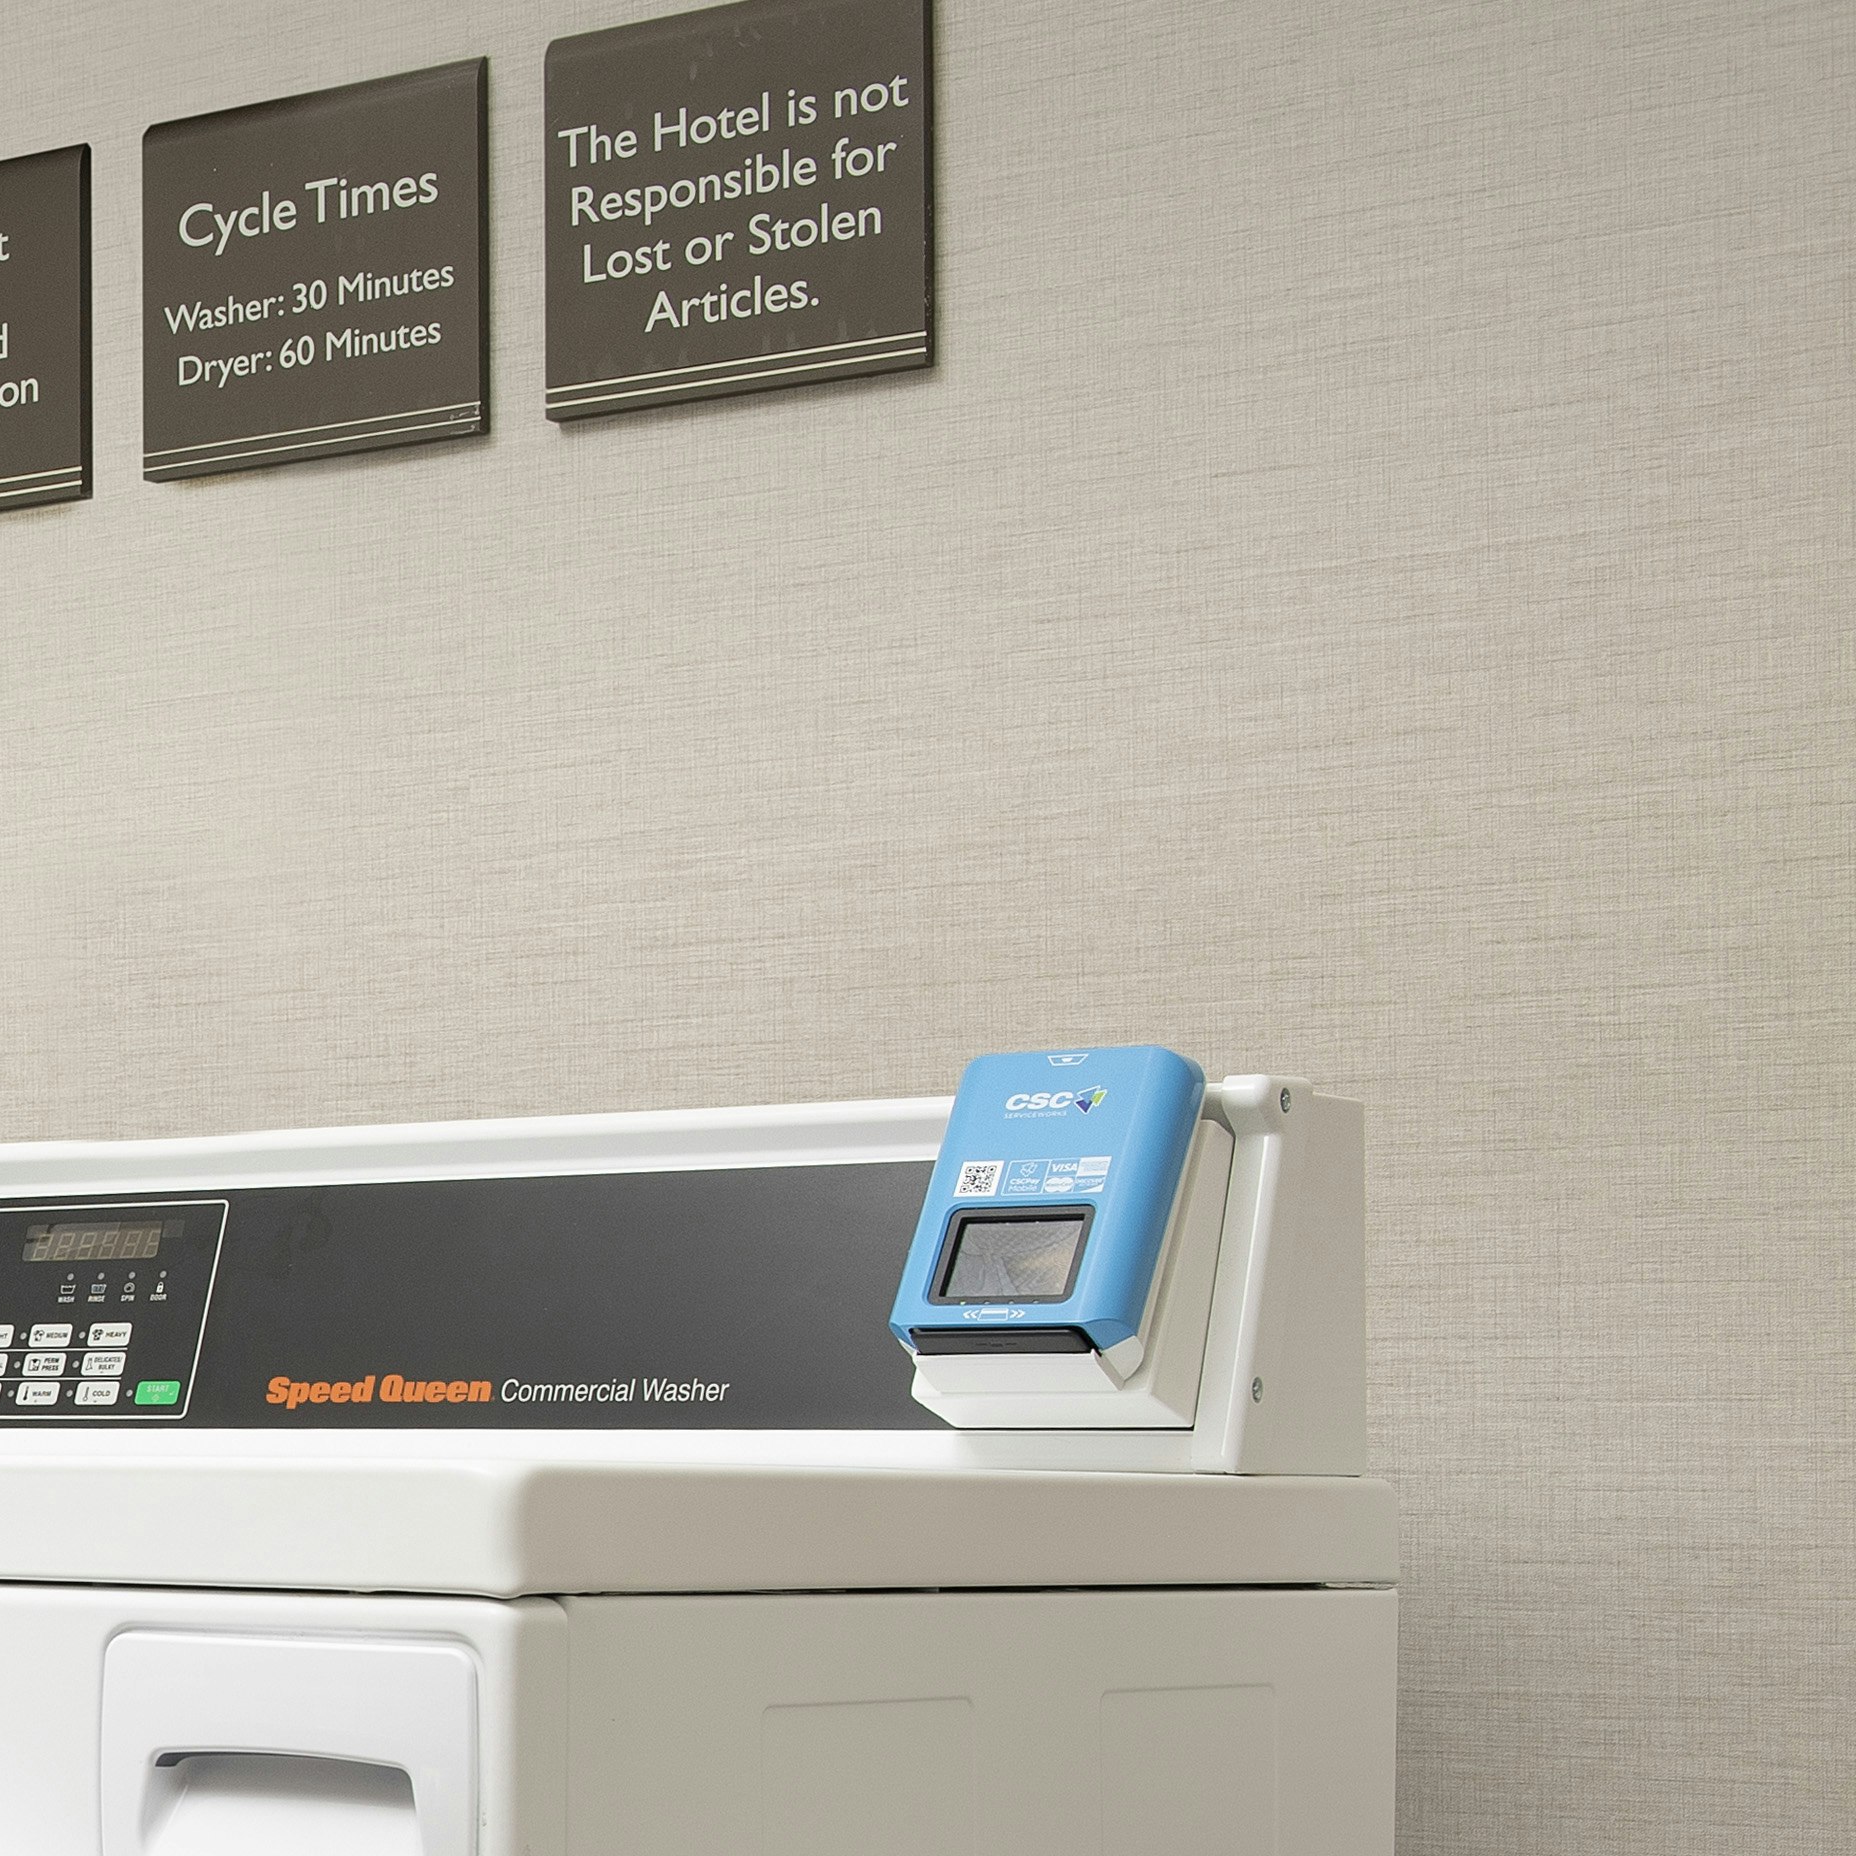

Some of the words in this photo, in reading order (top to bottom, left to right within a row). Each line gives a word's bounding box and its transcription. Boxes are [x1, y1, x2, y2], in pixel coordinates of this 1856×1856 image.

[557, 124, 637, 168] The
[654, 91, 769, 152] Hotel
[787, 89, 817, 127] is
[834, 75, 909, 118] not
[179, 190, 297, 256] Cycle
[304, 172, 438, 223] Times
[571, 148, 817, 226] Responsible
[831, 137, 897, 180] for
[583, 239, 672, 283] Lost
[685, 231, 735, 265] or
[749, 202, 881, 255] Stolen
[164, 295, 285, 335] Washer:
[292, 279, 327, 314] 30
[338, 265, 454, 306] Minutes
[644, 275, 819, 333] Articles.
[178, 350, 272, 389] Dryer:
[279, 335, 315, 369] 60
[326, 322, 442, 362] Minutes
[1005, 1091, 1074, 1111] CSC
[1052, 1162, 1078, 1172] VISA
[145, 1384, 170, 1393] START
[265, 1375, 376, 1410] Speed
[379, 1373, 492, 1403] Queen
[500, 1378, 637, 1403] Commercial
[642, 1378, 731, 1402] Washer
